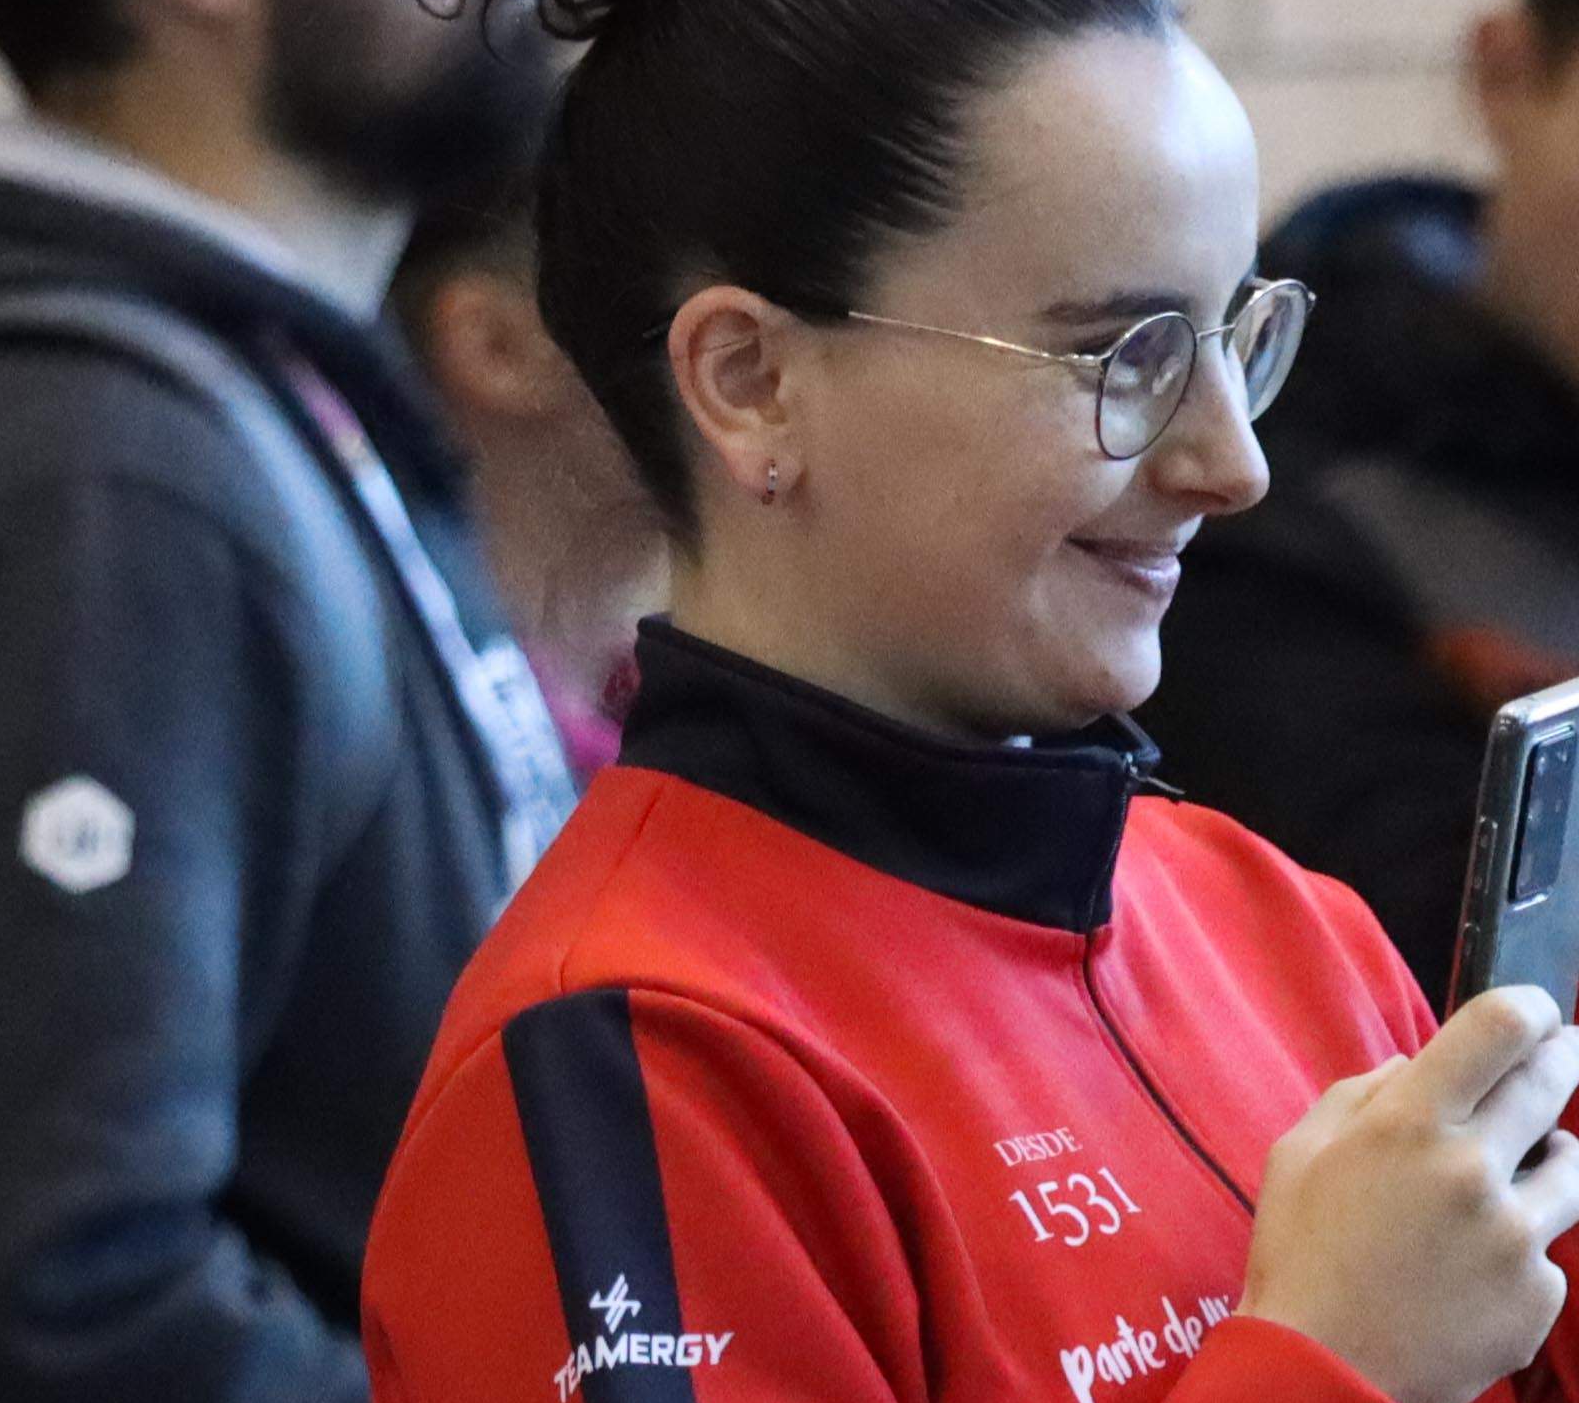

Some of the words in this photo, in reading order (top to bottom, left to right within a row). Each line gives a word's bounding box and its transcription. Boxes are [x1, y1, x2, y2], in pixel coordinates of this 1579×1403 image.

[993, 1126, 1083, 1167] DESDE
[1008, 1166, 1142, 1247] 1531
[1161, 1295, 1203, 1359] de
[553, 1332, 735, 1403] TEAMERGY
